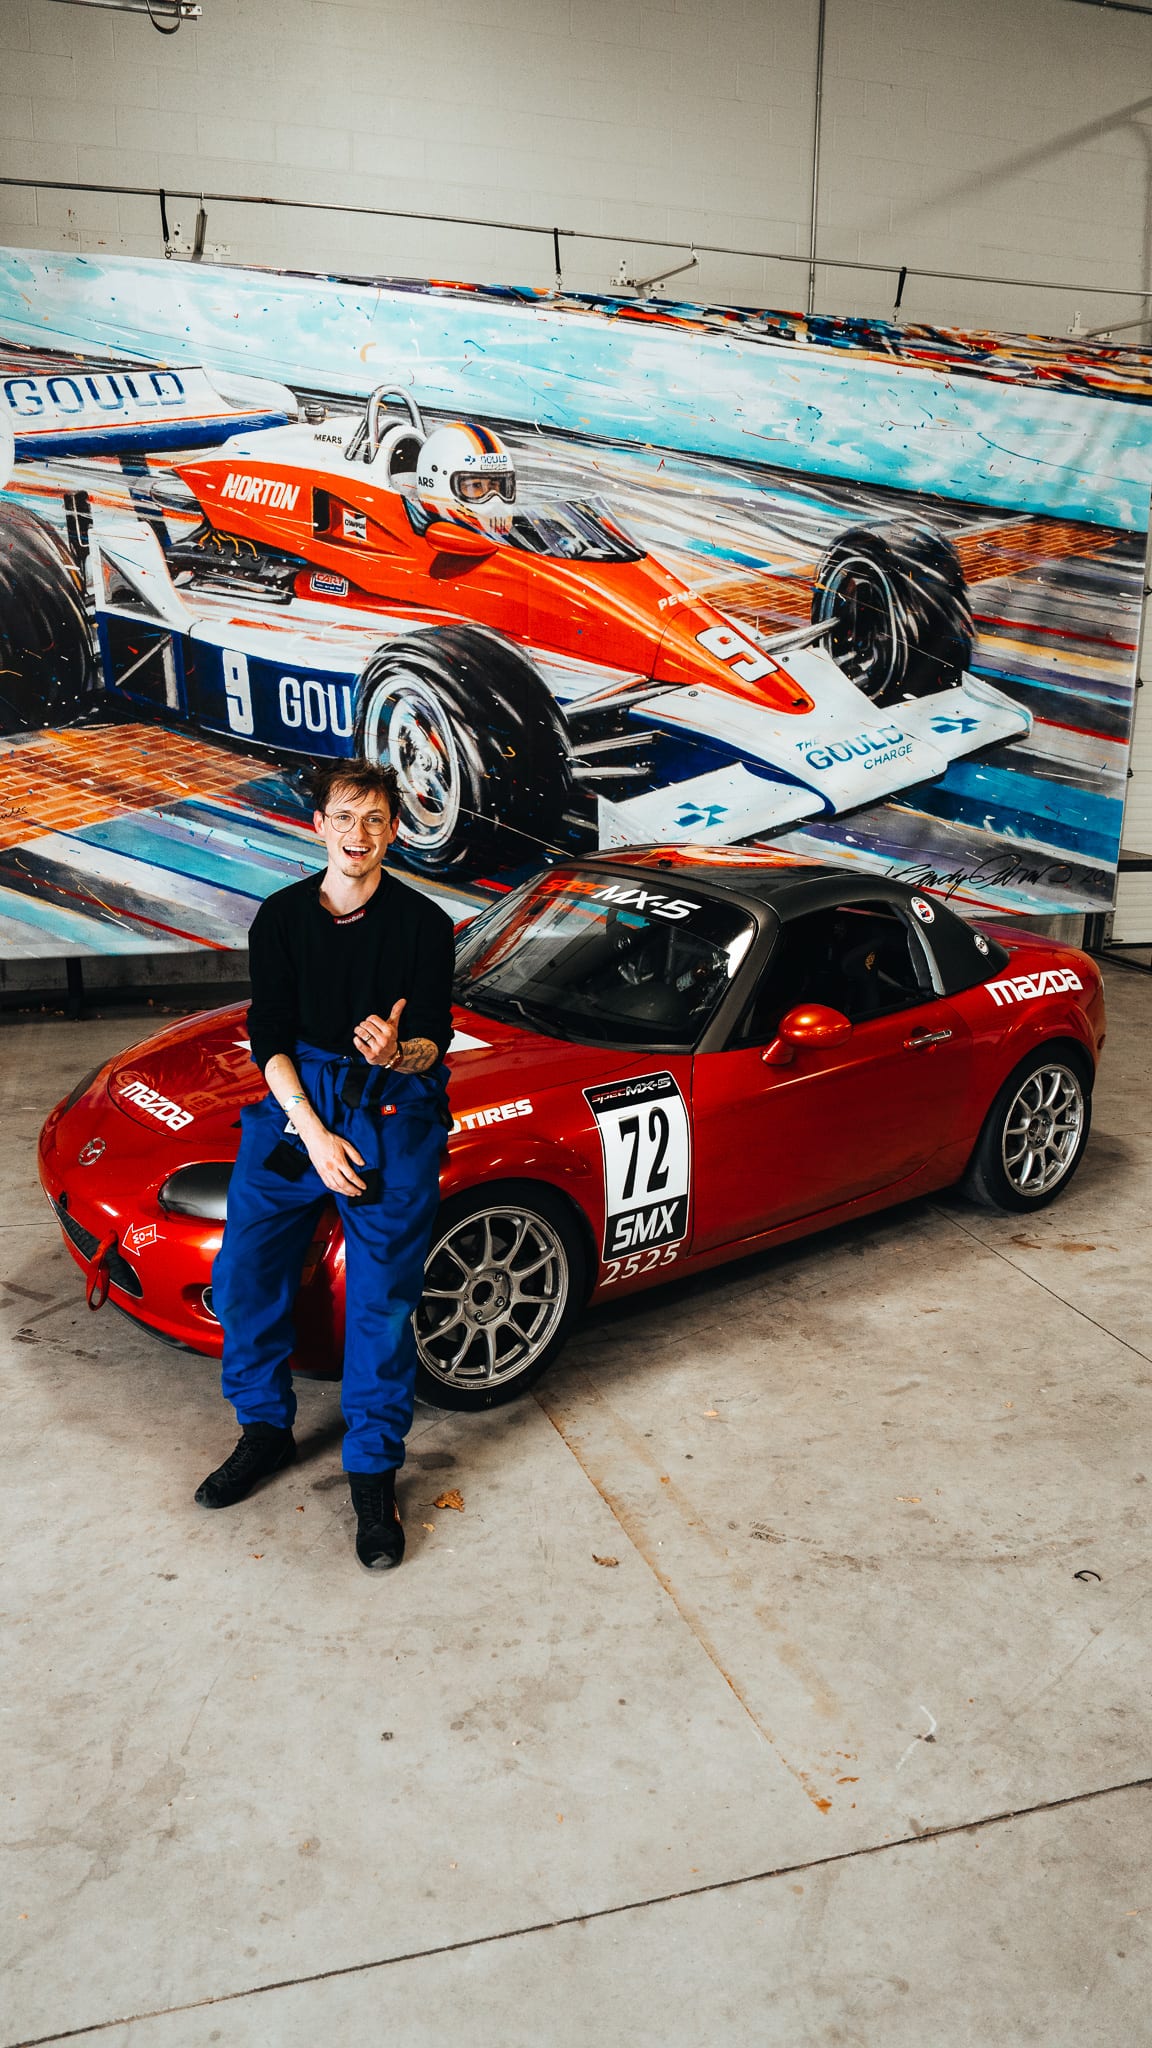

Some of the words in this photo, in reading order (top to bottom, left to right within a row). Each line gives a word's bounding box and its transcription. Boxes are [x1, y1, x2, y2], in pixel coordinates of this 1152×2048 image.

[3, 371, 187, 416] GOULD
[313, 433, 343, 444] MEARS
[220, 473, 301, 511] NORTON
[418, 476, 435, 488] ARS
[695, 626, 779, 683] 9
[222, 648, 254, 735] 9
[279, 677, 354, 737] GOU
[805, 725, 904, 770] GOULD
[863, 743, 914, 770] CHARGE
[461, 1098, 533, 1130] TIRES
[618, 1106, 669, 1200] 72
[132, 1230, 153, 1245] TOW
[612, 1201, 680, 1252] SMX
[600, 1243, 681, 1287] 2525
